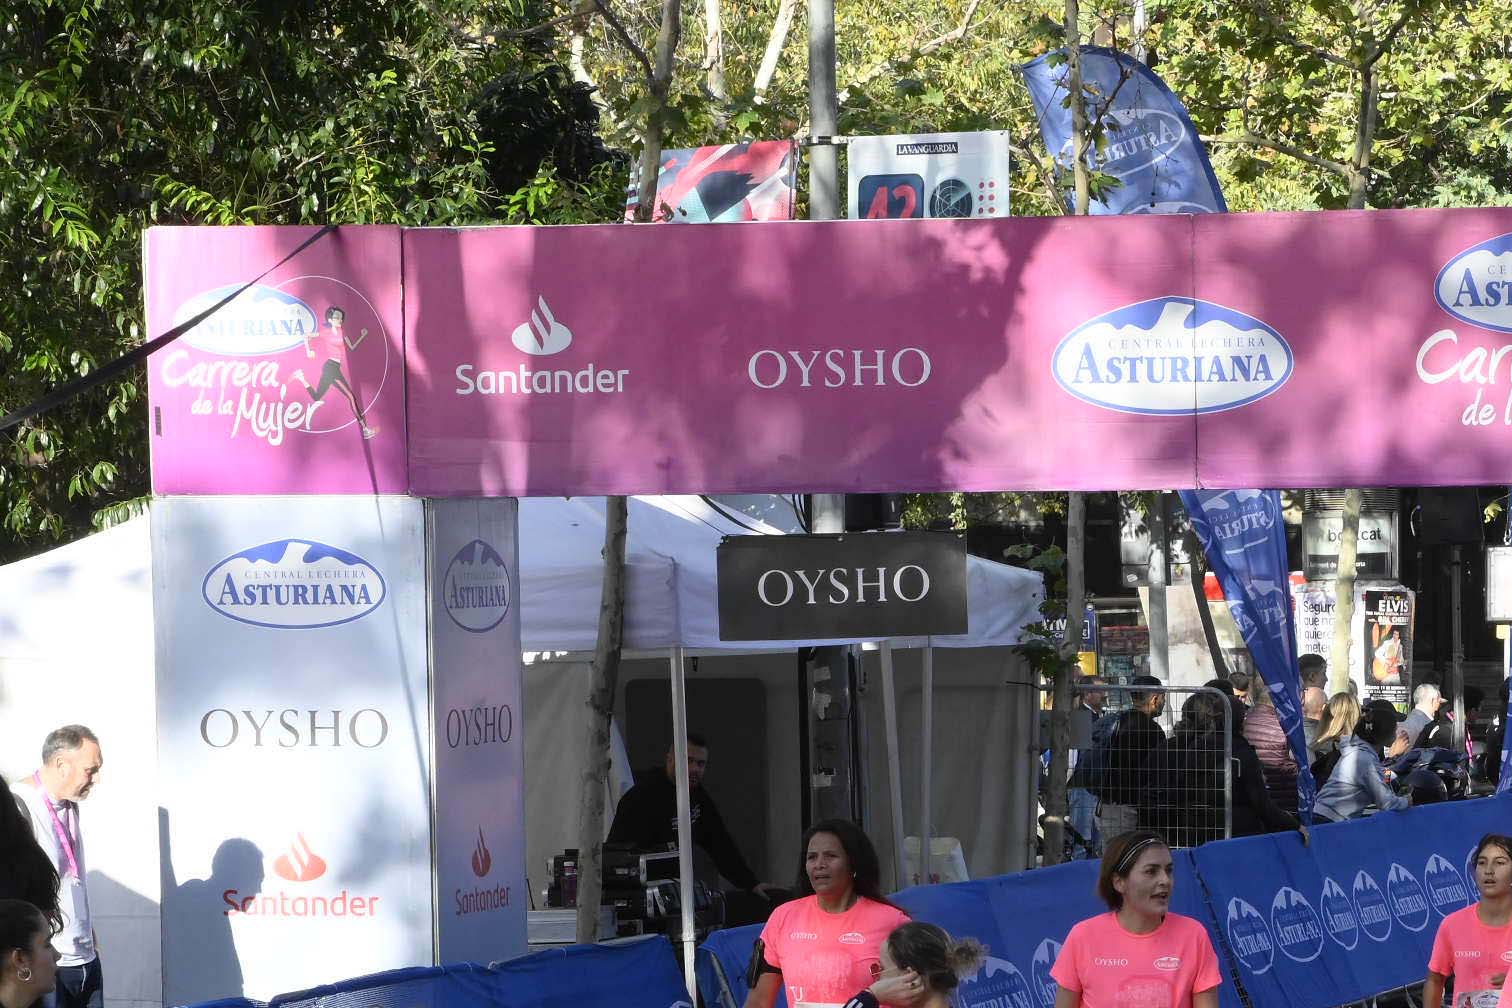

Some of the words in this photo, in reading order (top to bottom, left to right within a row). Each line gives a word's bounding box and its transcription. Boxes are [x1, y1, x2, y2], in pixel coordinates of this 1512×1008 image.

[160, 348, 280, 388] Carrera
[455, 363, 630, 395] Santander
[748, 347, 932, 388] OYSHO
[1071, 340, 1275, 384] ASTURIANA
[191, 390, 214, 416] de
[217, 387, 234, 416] la
[230, 384, 325, 446] Mujer
[1461, 391, 1496, 427] de
[217, 572, 373, 606] ASTURIANA
[449, 583, 508, 610] ASTURIANA
[757, 564, 930, 607] OYSHO
[1378, 599, 1409, 613] ELVIS
[200, 708, 389, 749] OYSHO
[446, 703, 512, 749] OYSHO
[222, 888, 381, 917] Santander
[455, 882, 511, 917] Santander
